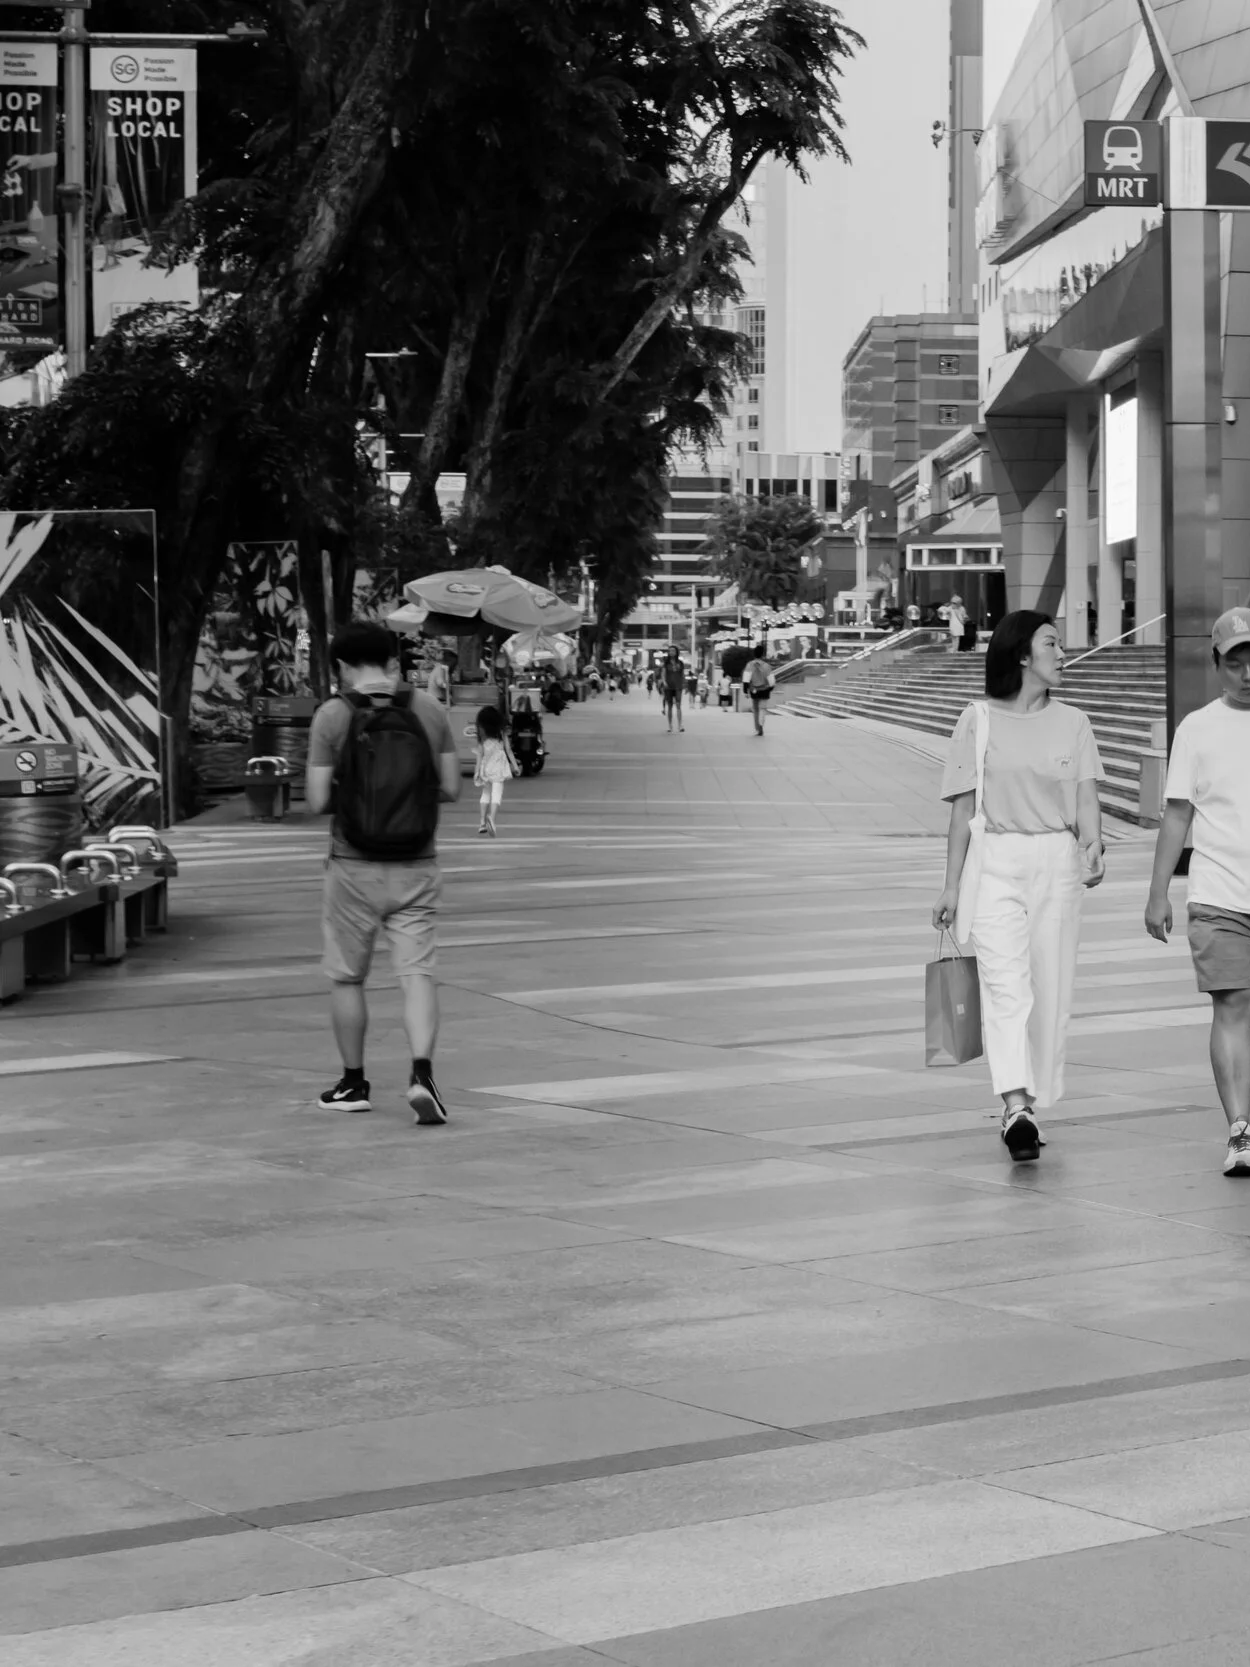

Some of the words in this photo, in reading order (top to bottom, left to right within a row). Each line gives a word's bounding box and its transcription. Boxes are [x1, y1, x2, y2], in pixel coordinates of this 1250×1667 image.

[115, 63, 136, 75] SG
[107, 97, 181, 117] SHOP
[107, 121, 182, 138] LOCAL
[1097, 177, 1148, 199] MRT
